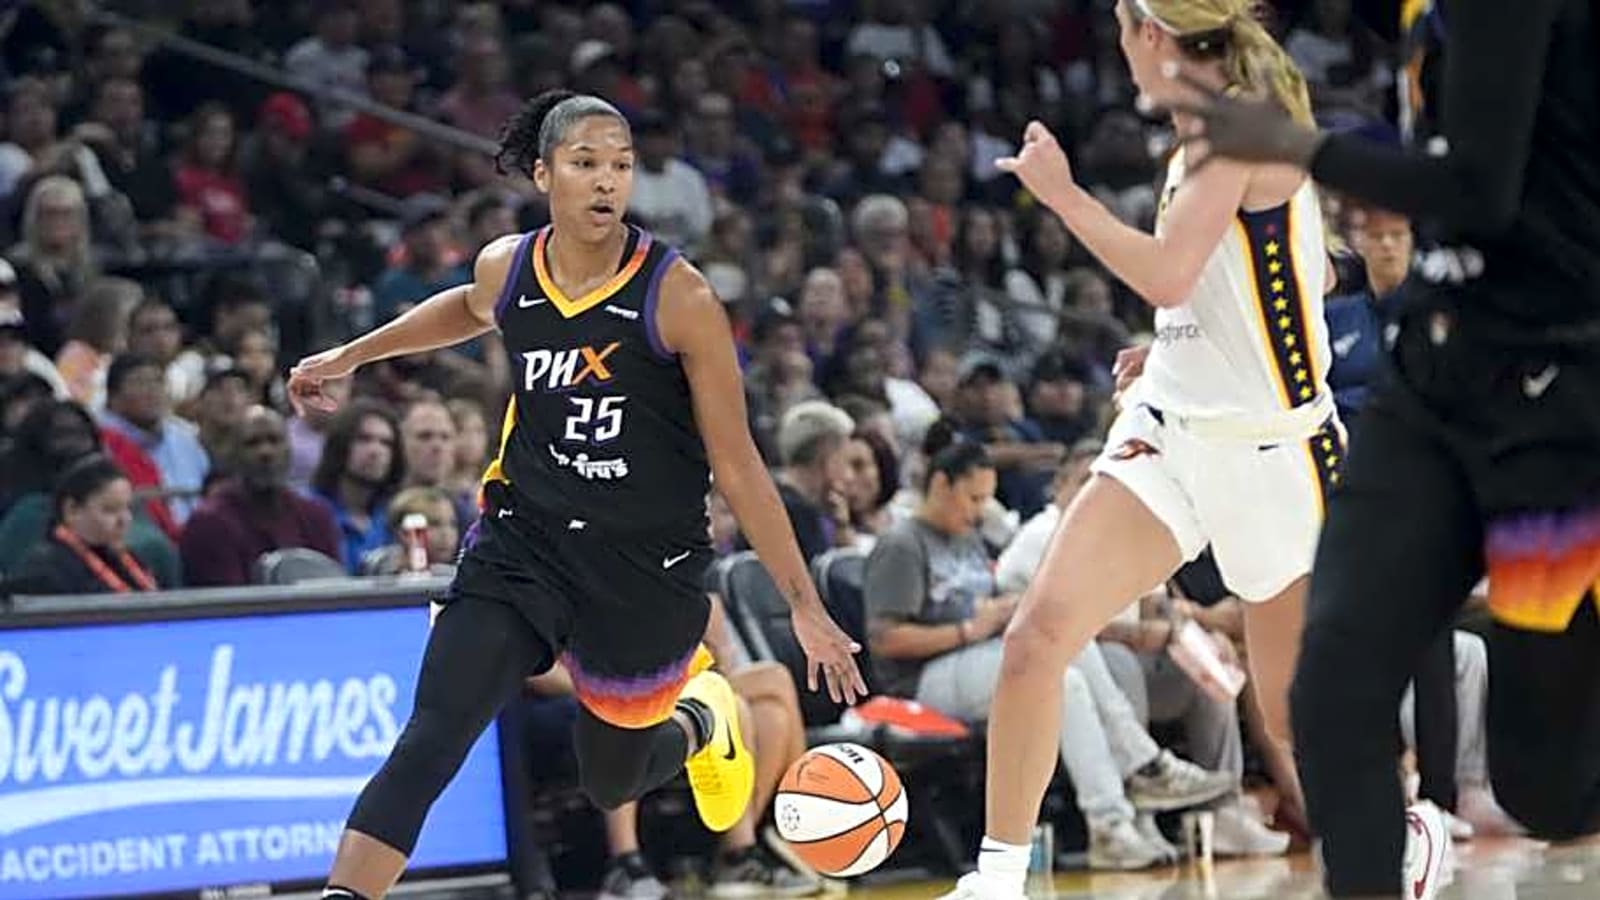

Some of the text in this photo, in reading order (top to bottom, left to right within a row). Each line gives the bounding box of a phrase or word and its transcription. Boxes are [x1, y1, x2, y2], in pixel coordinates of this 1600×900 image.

[521, 341, 621, 391] PHX
[564, 396, 627, 441] 25
[1, 833, 187, 882] ACCIDENT
